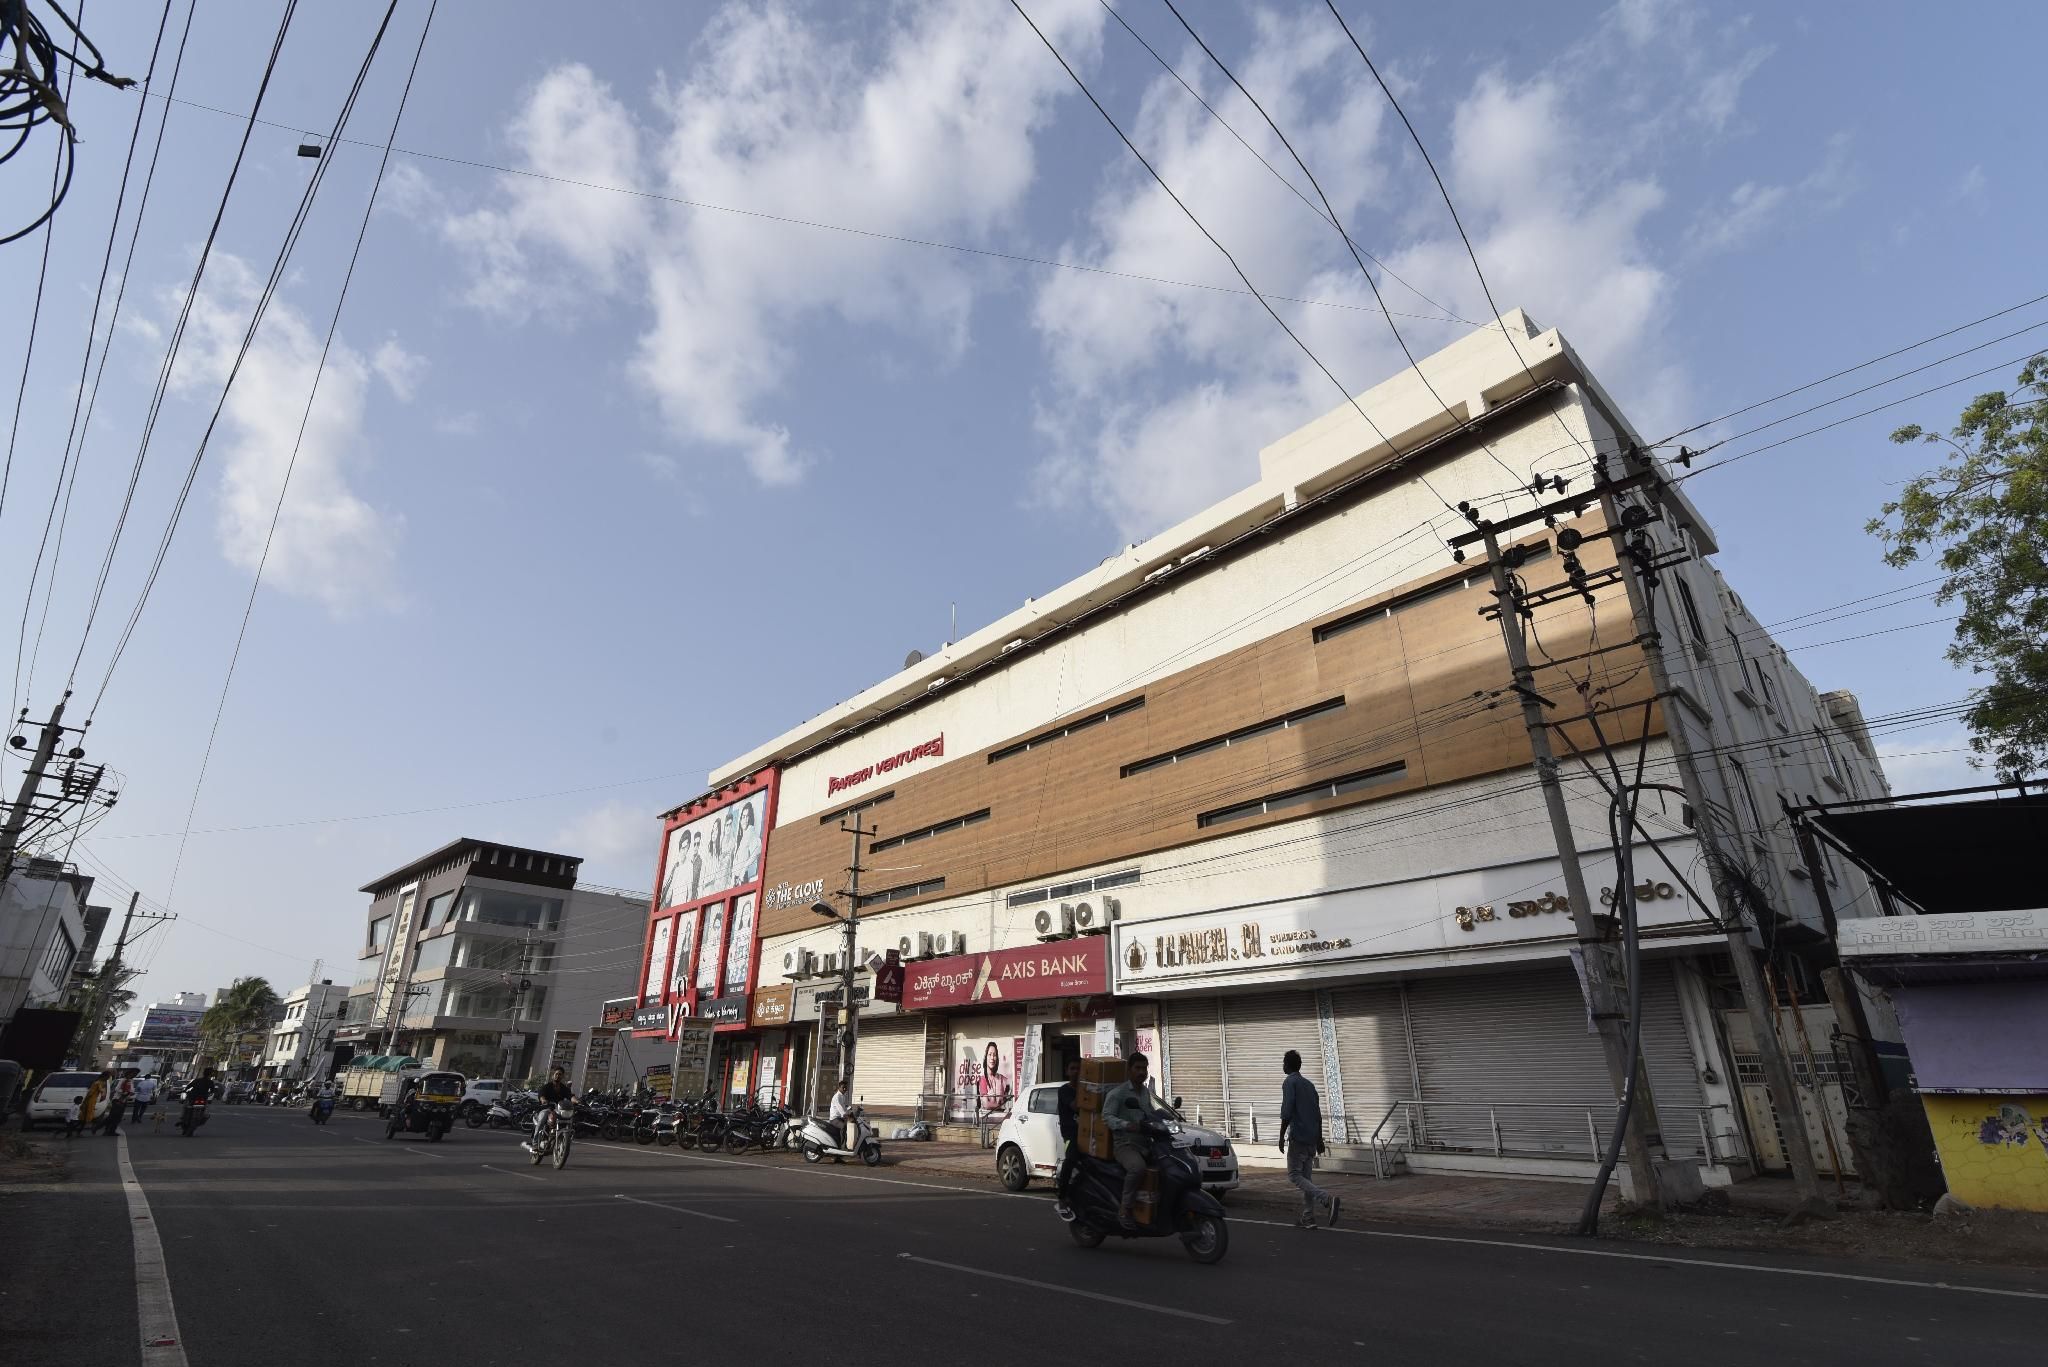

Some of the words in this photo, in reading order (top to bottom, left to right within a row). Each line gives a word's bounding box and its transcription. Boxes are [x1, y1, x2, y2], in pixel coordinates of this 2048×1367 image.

[828, 765, 874, 798] PAREKH
[876, 733, 943, 775] VENTURES
[777, 887, 793, 903] THE
[794, 879, 824, 899] CLOVE
[1856, 930, 1926, 944] Ruchi
[1930, 929, 1984, 941] Pan
[1001, 960, 1035, 981] AXIS
[1041, 953, 1088, 976] BANK
[959, 1059, 971, 1075] dil
[971, 1063, 982, 1075] se
